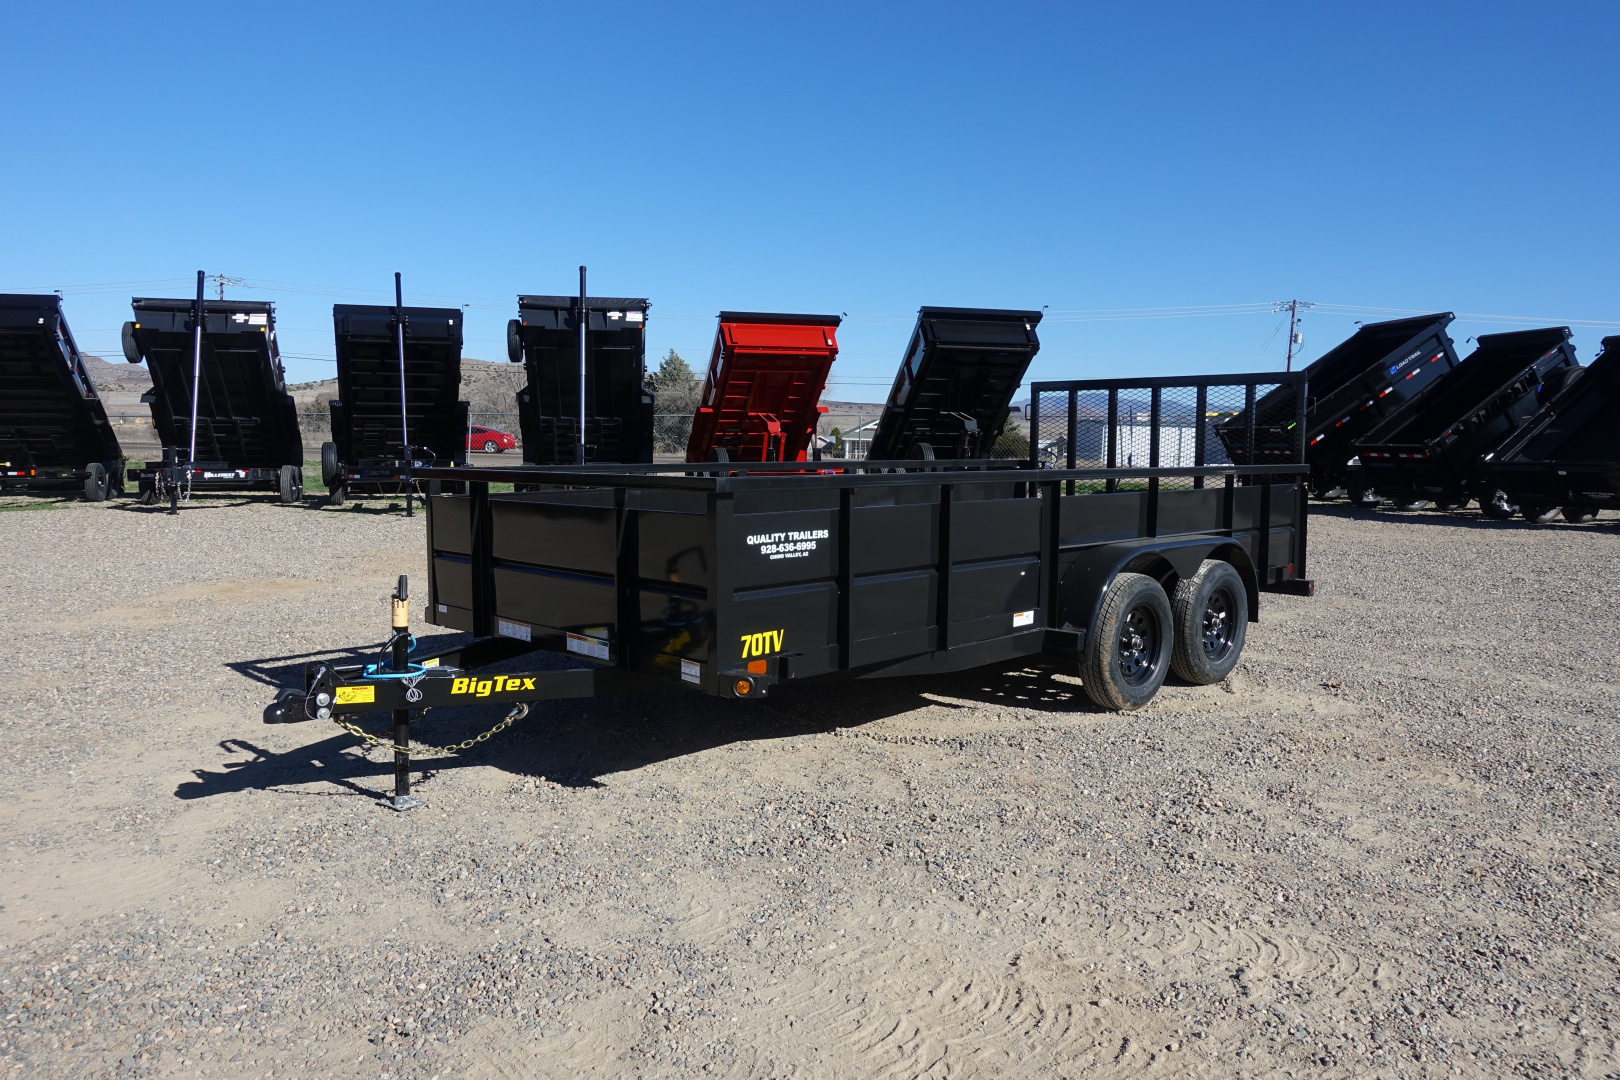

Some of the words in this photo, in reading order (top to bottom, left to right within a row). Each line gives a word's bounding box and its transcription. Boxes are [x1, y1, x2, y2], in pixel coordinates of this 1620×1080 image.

[747, 532, 786, 545] QUALITY
[787, 529, 829, 541] TRAILERS
[760, 540, 817, 554] 928-636-6995
[740, 628, 785, 659] 70TV
